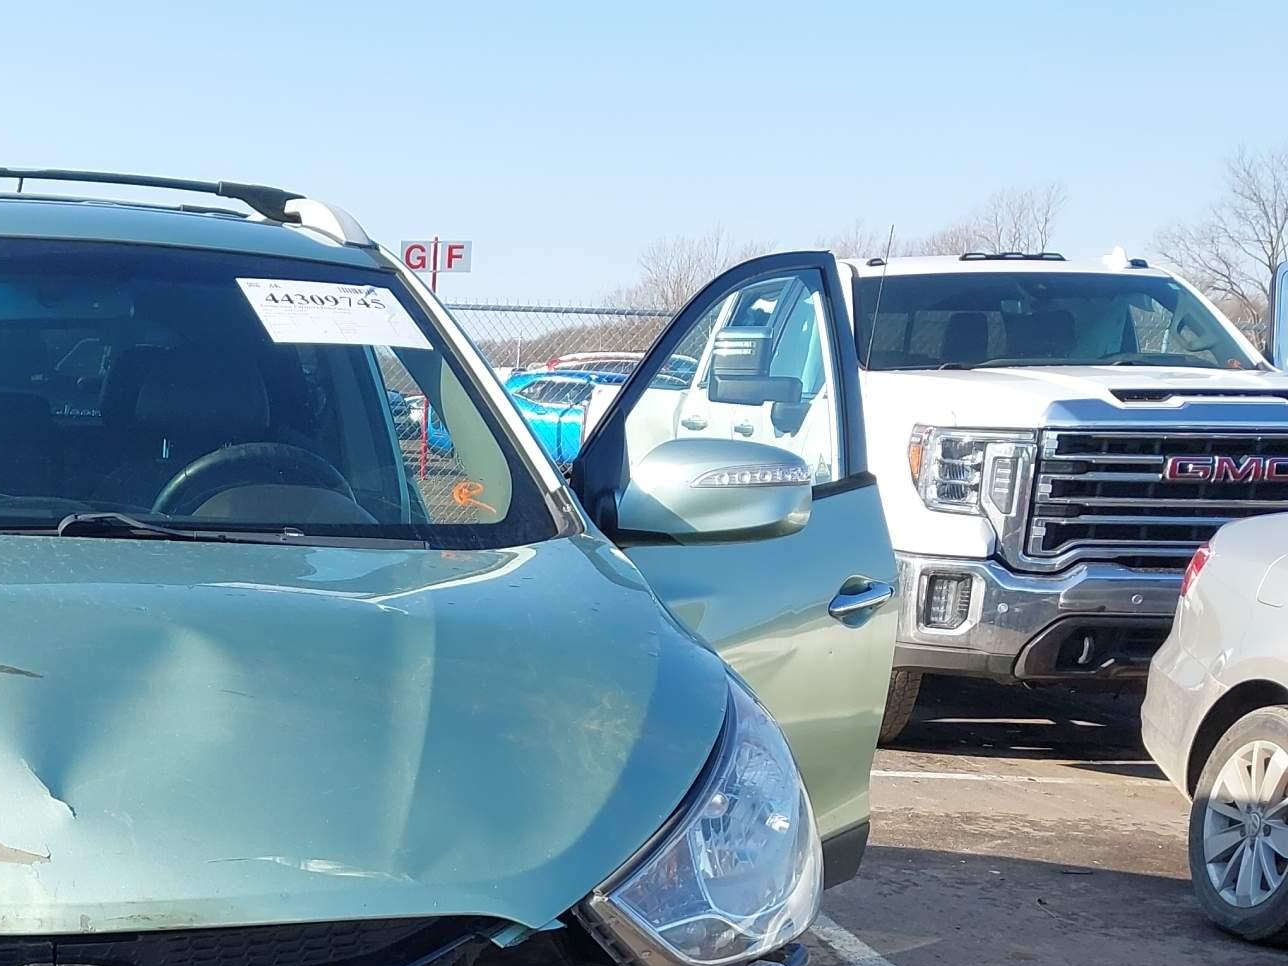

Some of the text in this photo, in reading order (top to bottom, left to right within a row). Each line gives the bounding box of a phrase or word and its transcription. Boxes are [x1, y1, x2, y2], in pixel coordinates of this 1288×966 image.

[405, 244, 465, 270] G F
[265, 291, 387, 310] 44309745
[1165, 456, 1288, 482] GMC
